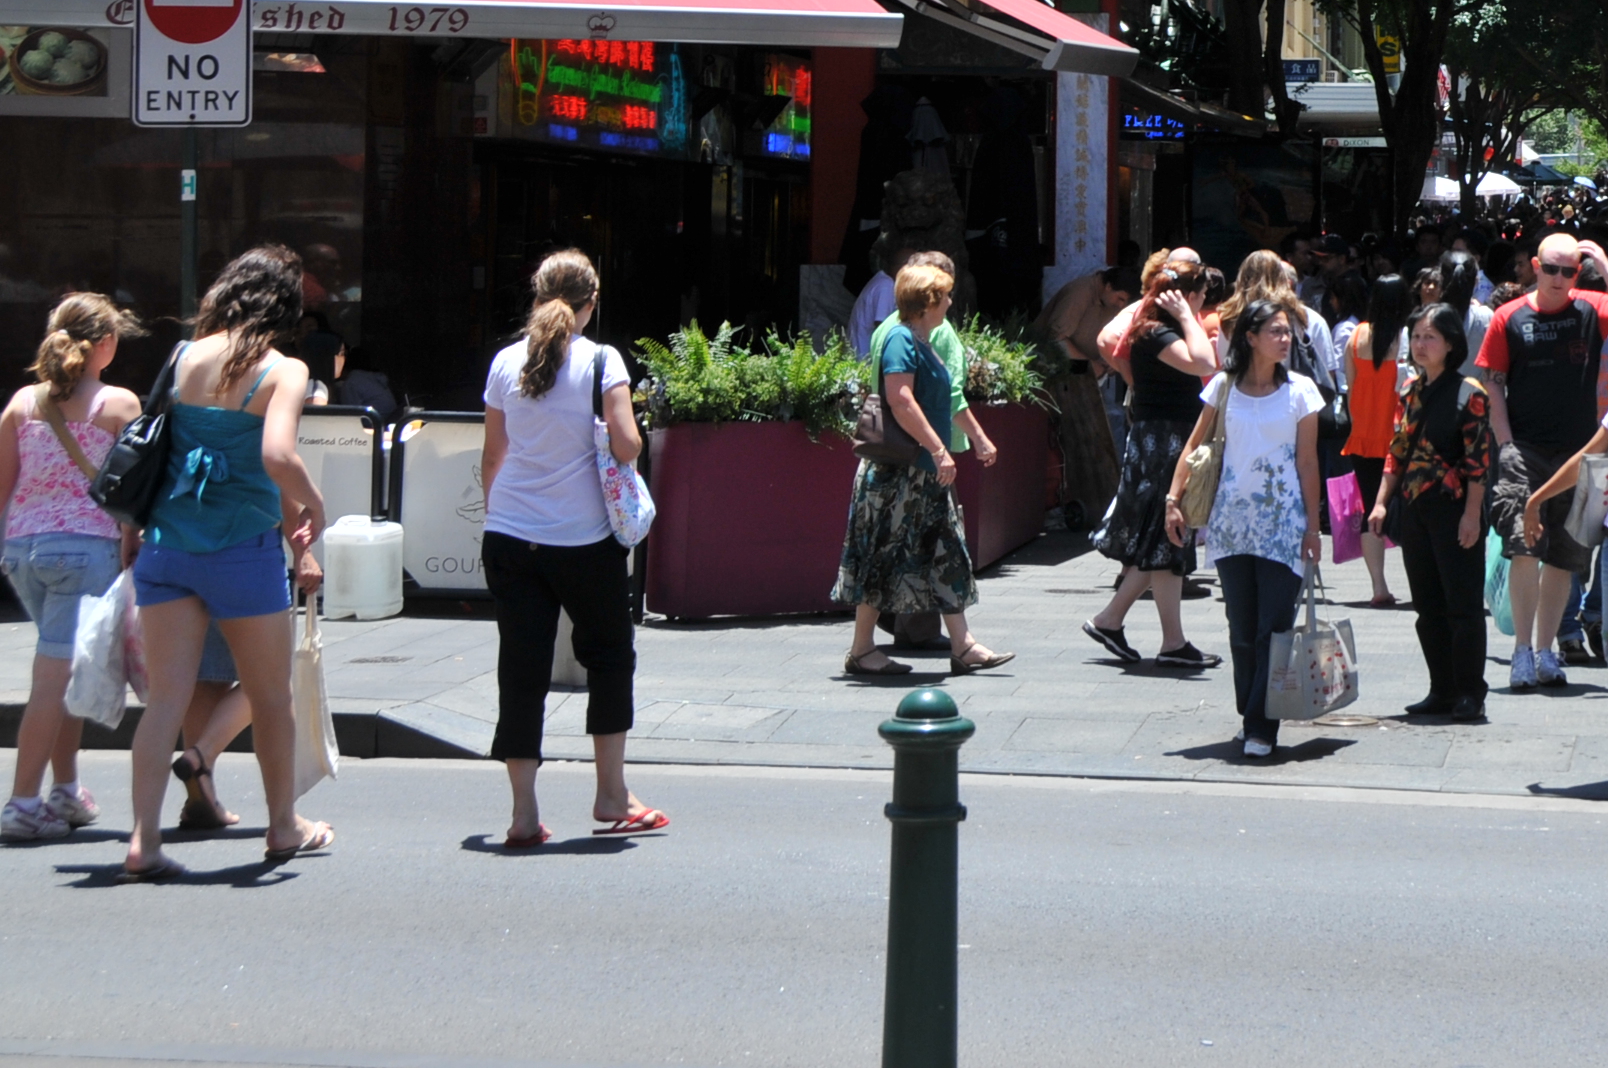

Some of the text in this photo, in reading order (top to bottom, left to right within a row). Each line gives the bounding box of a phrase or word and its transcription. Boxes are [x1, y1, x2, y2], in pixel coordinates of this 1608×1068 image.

[388, 6, 469, 33] 1979
[167, 54, 220, 80] NO
[146, 90, 240, 111] ENTRY
[339, 436, 368, 446] Coffee
